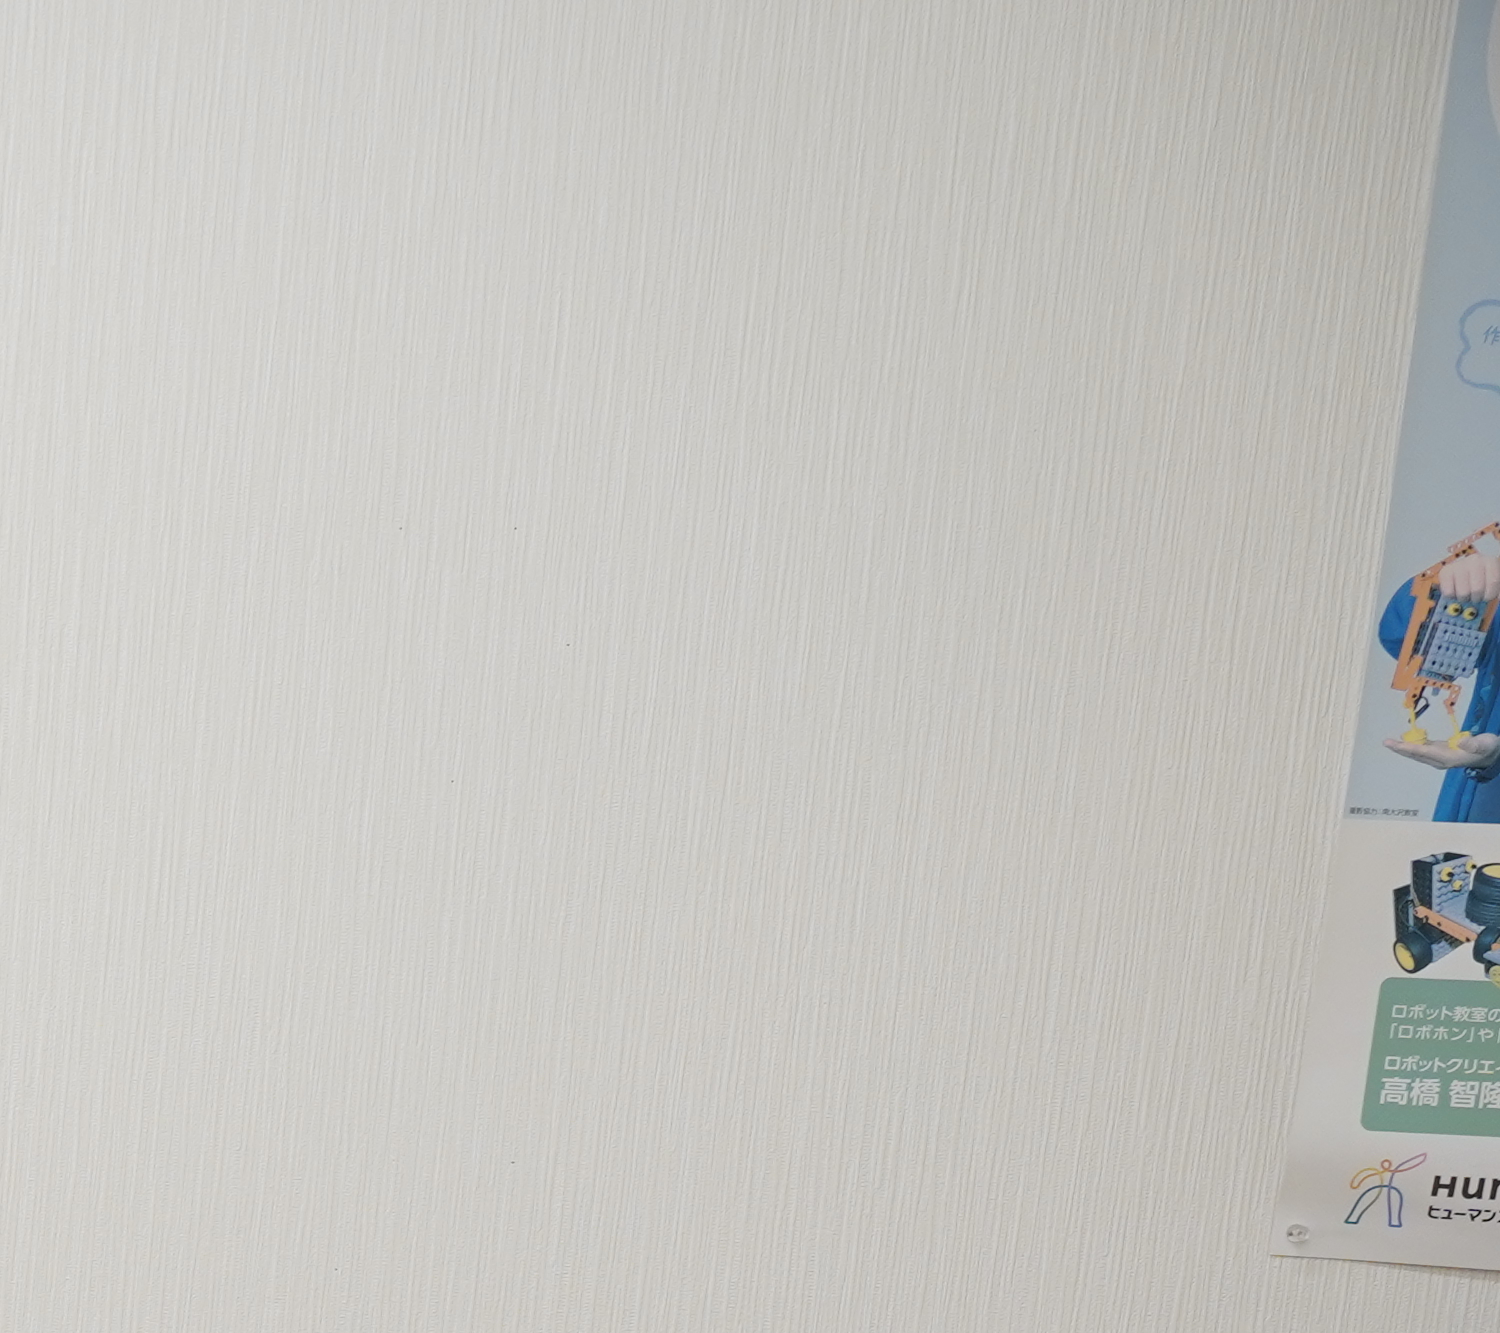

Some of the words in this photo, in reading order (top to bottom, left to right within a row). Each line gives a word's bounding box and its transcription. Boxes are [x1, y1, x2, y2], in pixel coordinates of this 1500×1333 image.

[1383, 1056, 1500, 1075] ロボットクリエ
[1379, 1077, 1441, 1107] 高橋
[1427, 1205, 1500, 1223] ヒューマン
